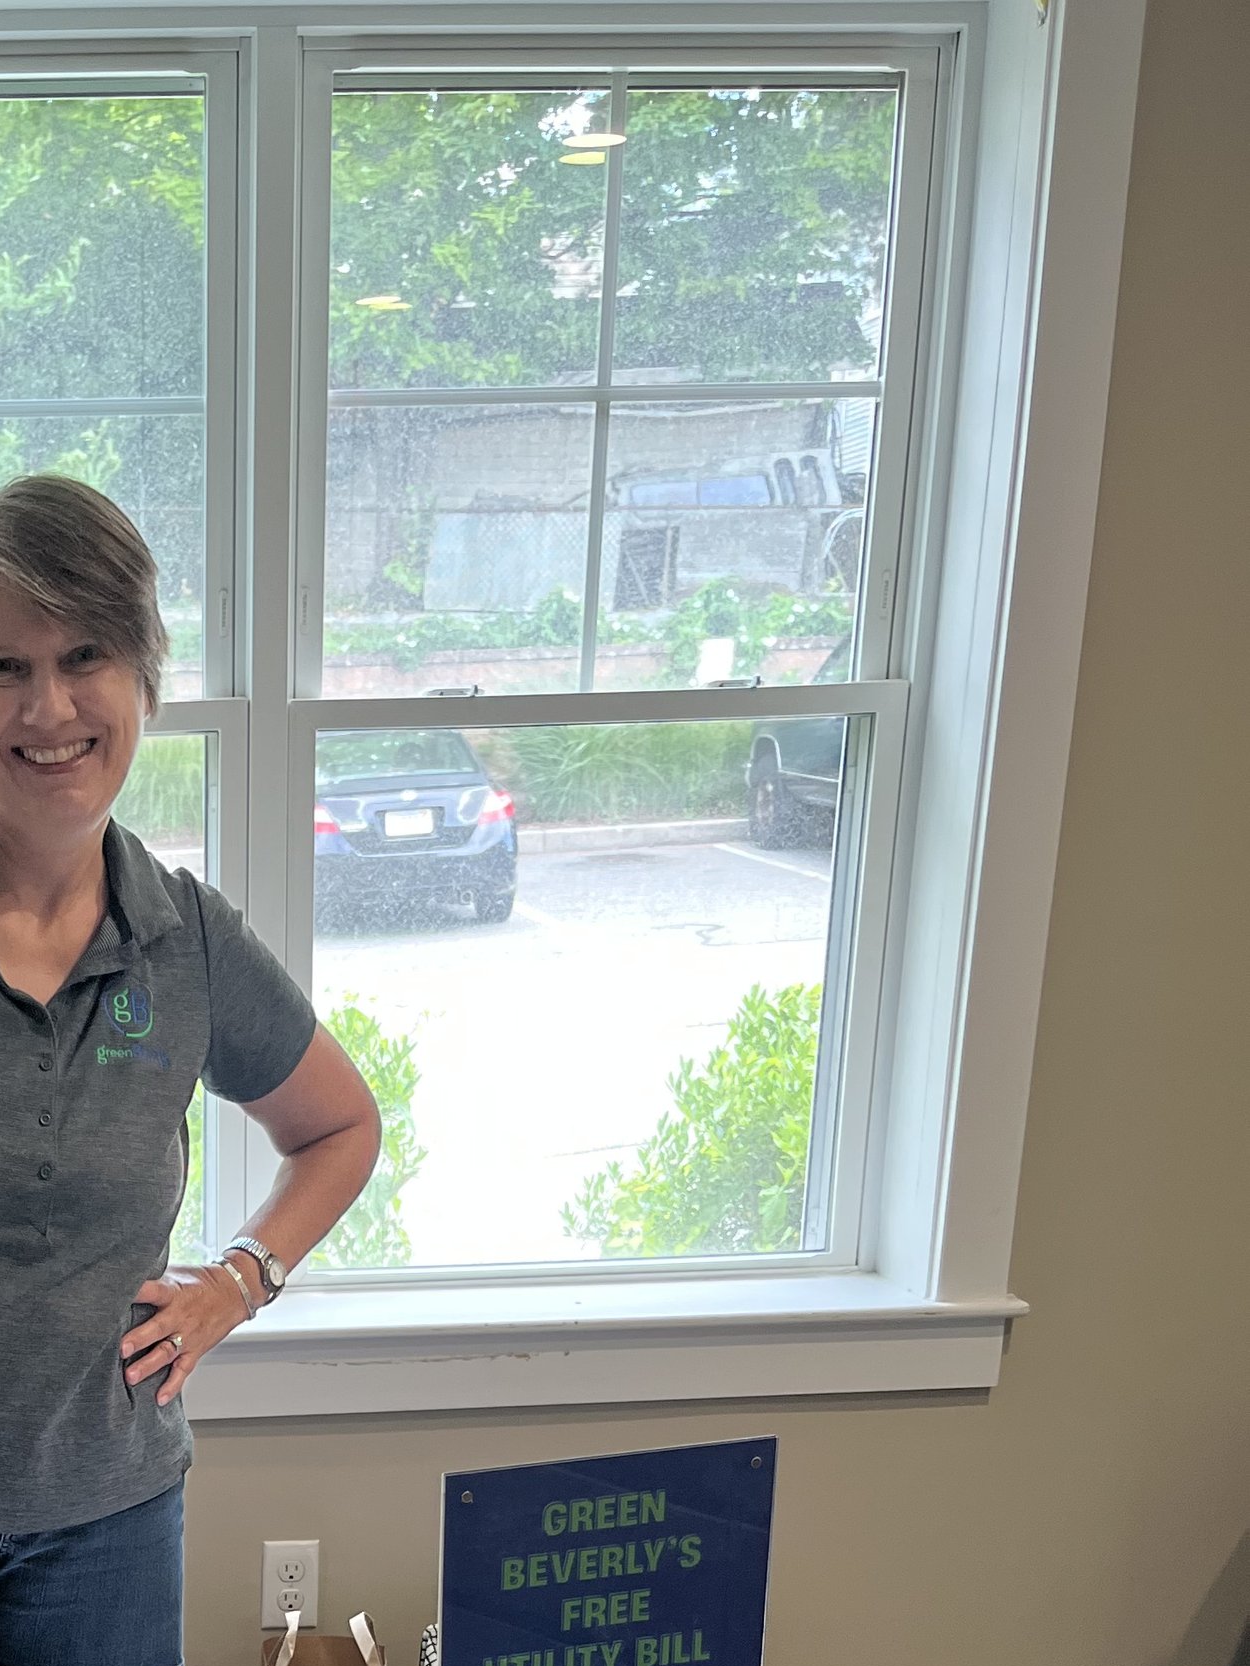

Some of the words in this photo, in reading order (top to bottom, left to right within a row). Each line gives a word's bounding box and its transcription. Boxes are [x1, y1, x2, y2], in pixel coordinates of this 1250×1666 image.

[542, 1489, 667, 1537] GREEN
[501, 1535, 702, 1591] BEVERLY'S
[561, 1590, 651, 1631] FREE
